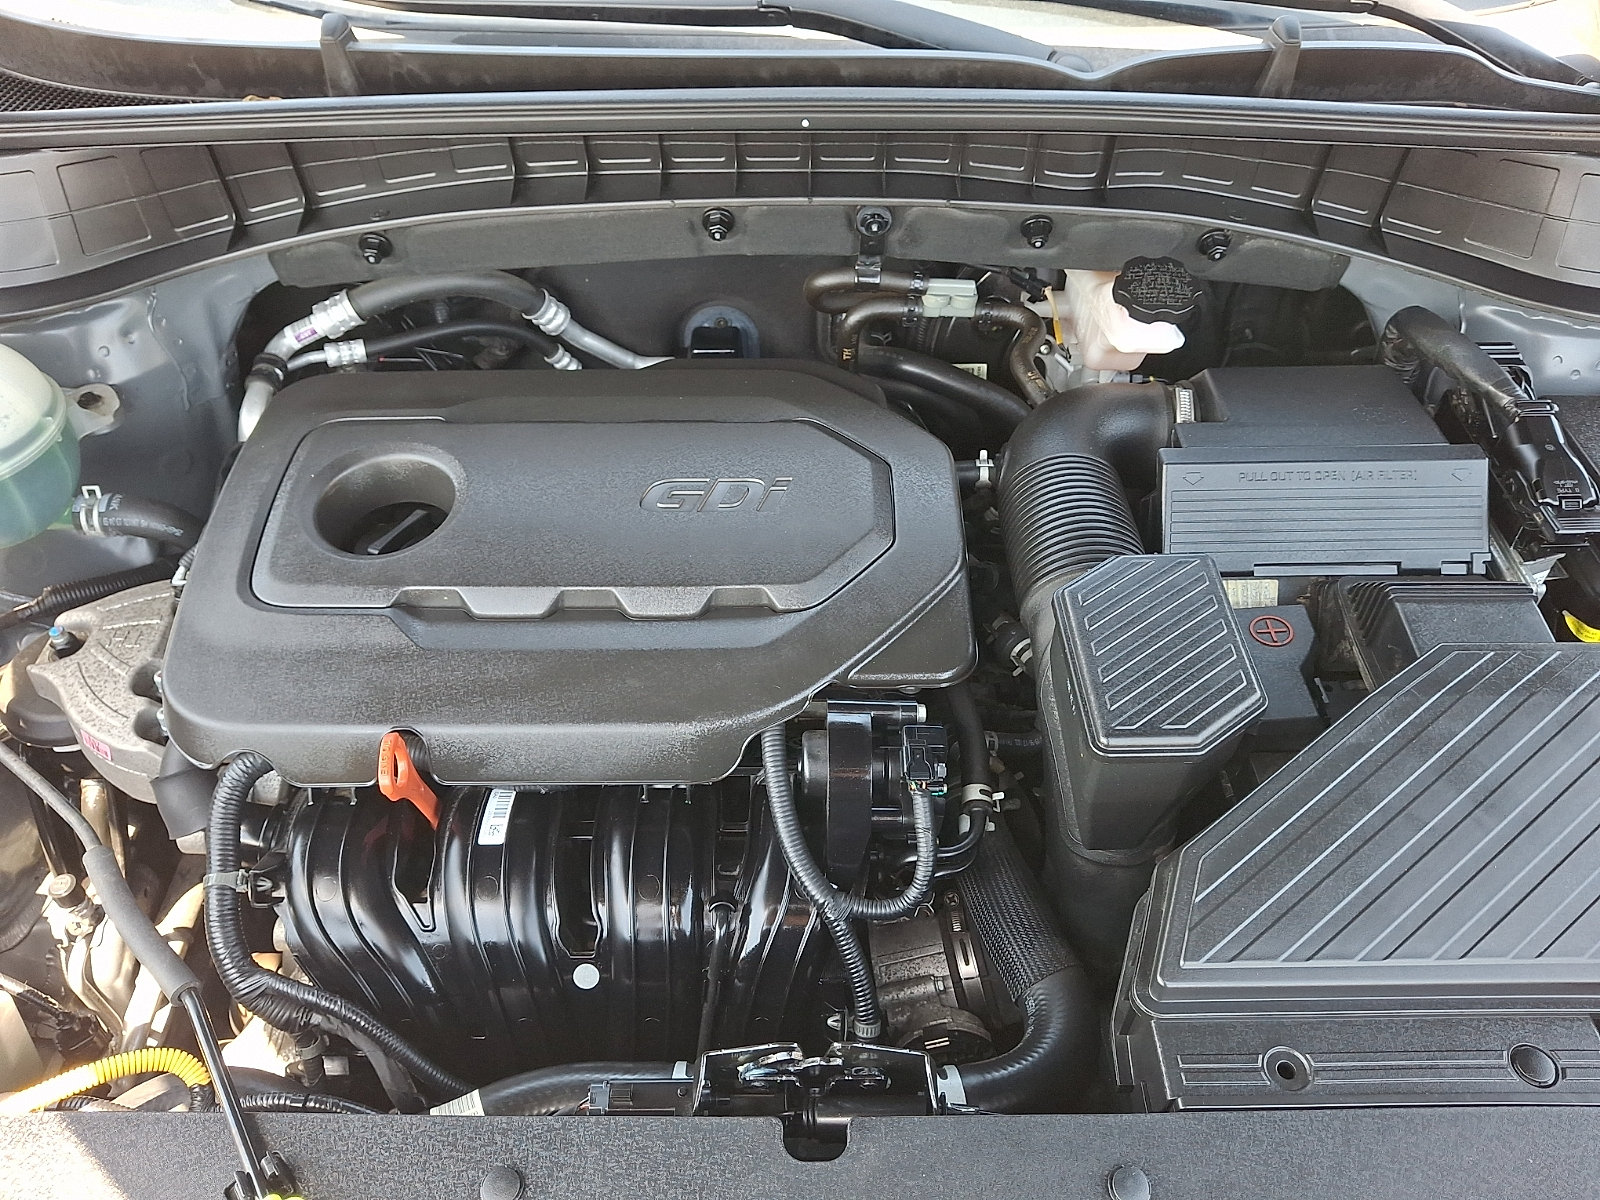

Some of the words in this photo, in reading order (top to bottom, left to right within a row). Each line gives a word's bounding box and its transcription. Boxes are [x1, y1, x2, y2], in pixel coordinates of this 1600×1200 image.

[1238, 471, 1268, 483] PULL
[1270, 470, 1294, 482] OUT
[1296, 470, 1311, 481] TO
[1314, 470, 1346, 481] OPEN
[382, 739, 391, 753] OIL
[380, 756, 388, 776] ENG
